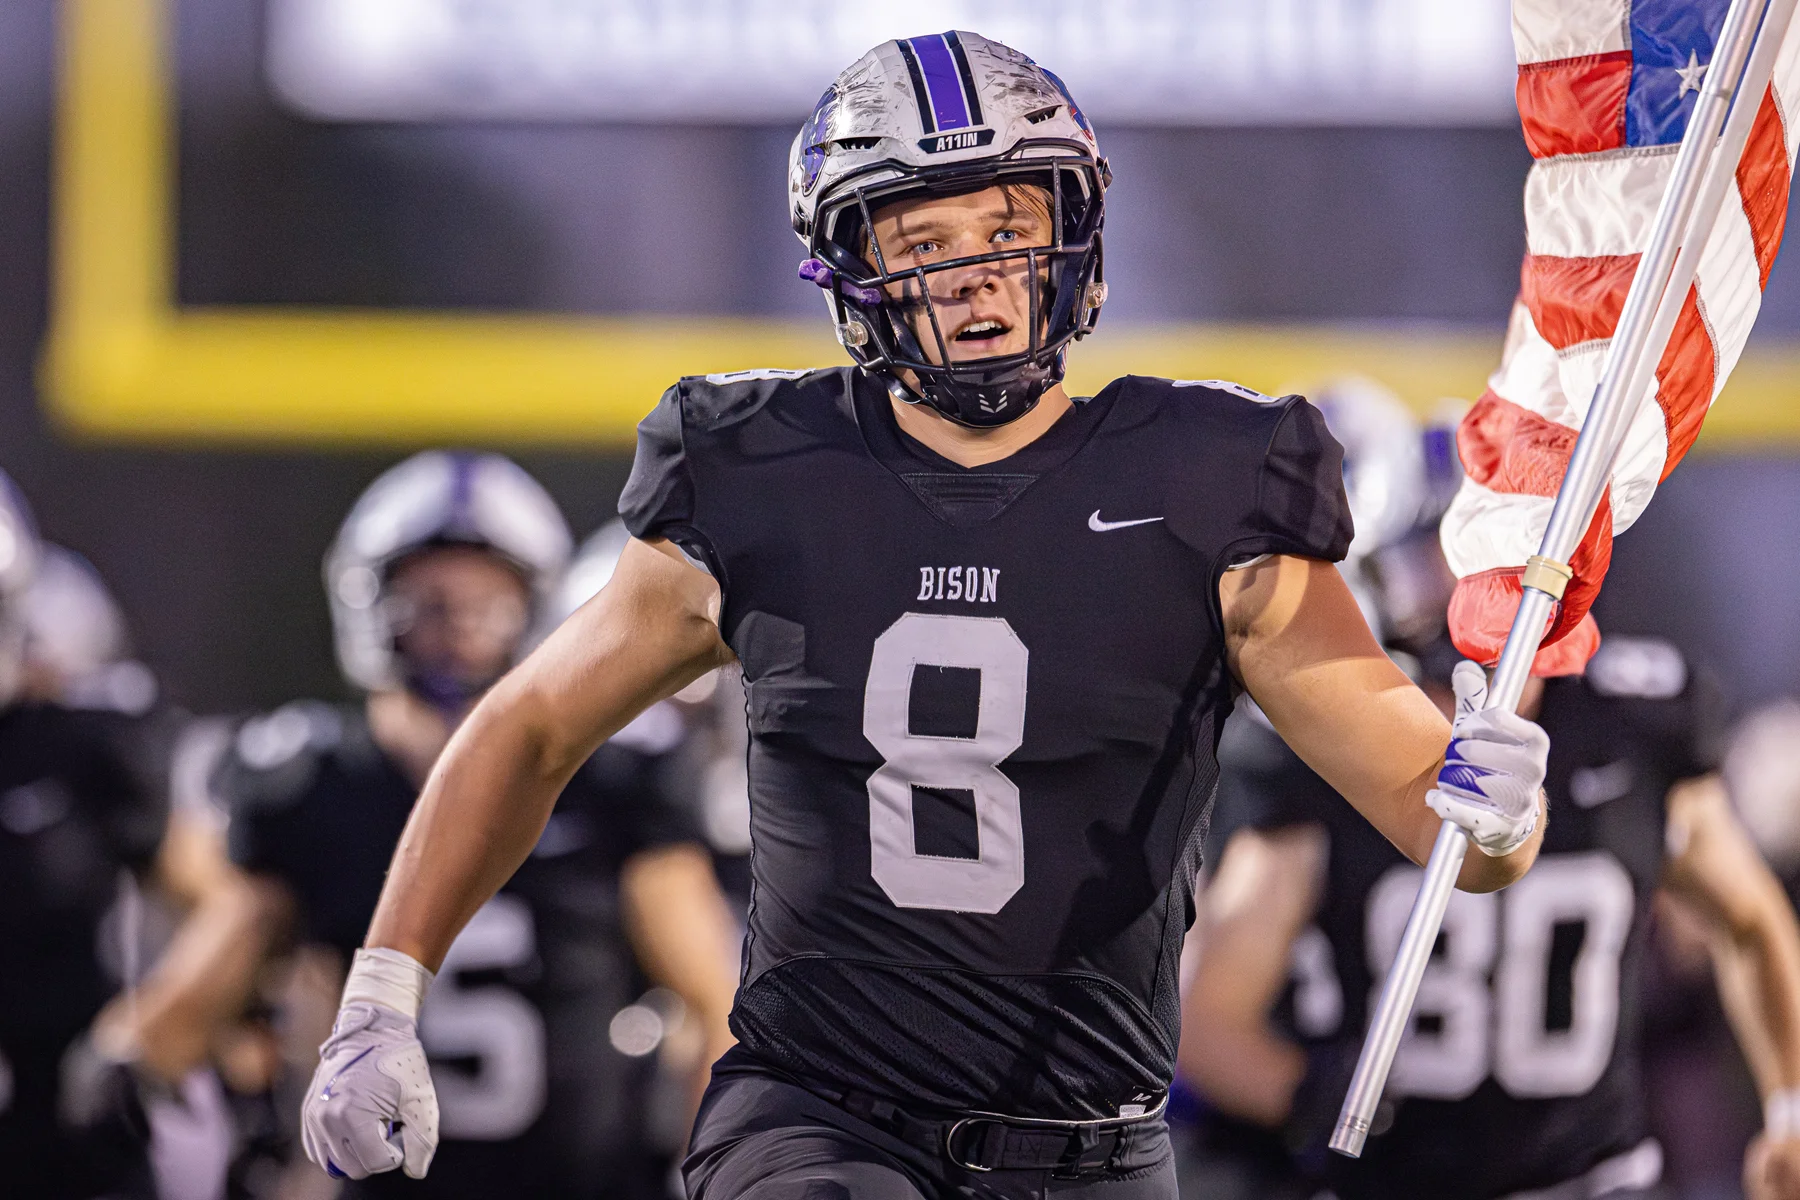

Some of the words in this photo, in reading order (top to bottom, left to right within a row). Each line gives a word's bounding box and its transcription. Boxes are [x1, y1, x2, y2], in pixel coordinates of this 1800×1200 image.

[917, 566, 1000, 602] BISON
[863, 611, 1029, 914] 8
[417, 892, 548, 1141] 5
[1366, 855, 1634, 1099] 80
